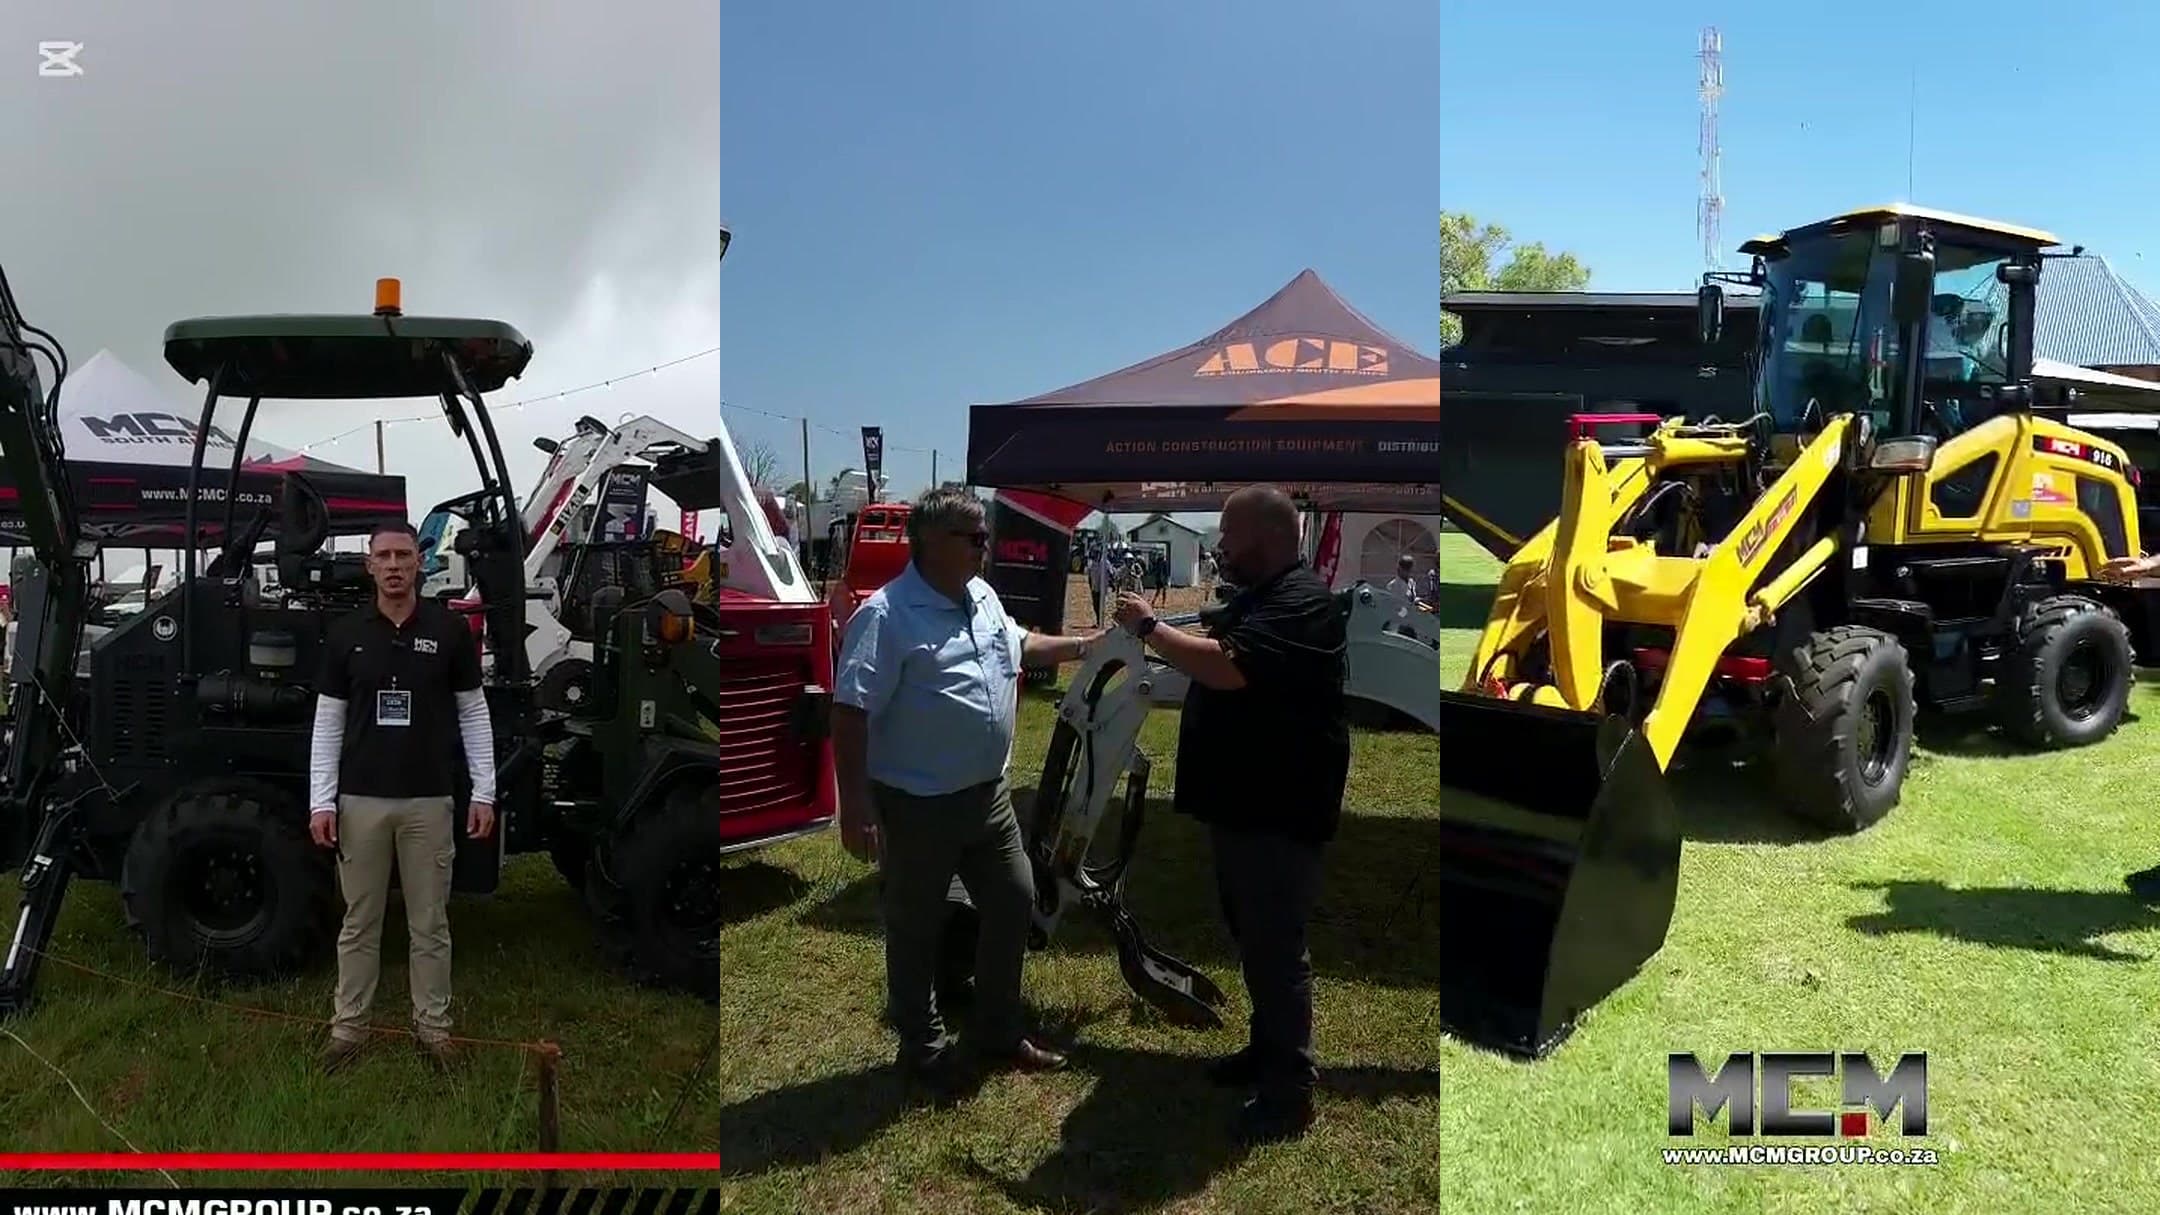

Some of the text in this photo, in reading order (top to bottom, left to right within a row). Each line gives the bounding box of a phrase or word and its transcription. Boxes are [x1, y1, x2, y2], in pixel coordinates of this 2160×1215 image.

[1195, 337, 1389, 373] ACE
[101, 436, 170, 446] SOUTH
[1105, 440, 1156, 453] ACTION
[1162, 439, 1271, 453] CONSTRUCTION
[1277, 439, 1366, 452] EQUIPMENT
